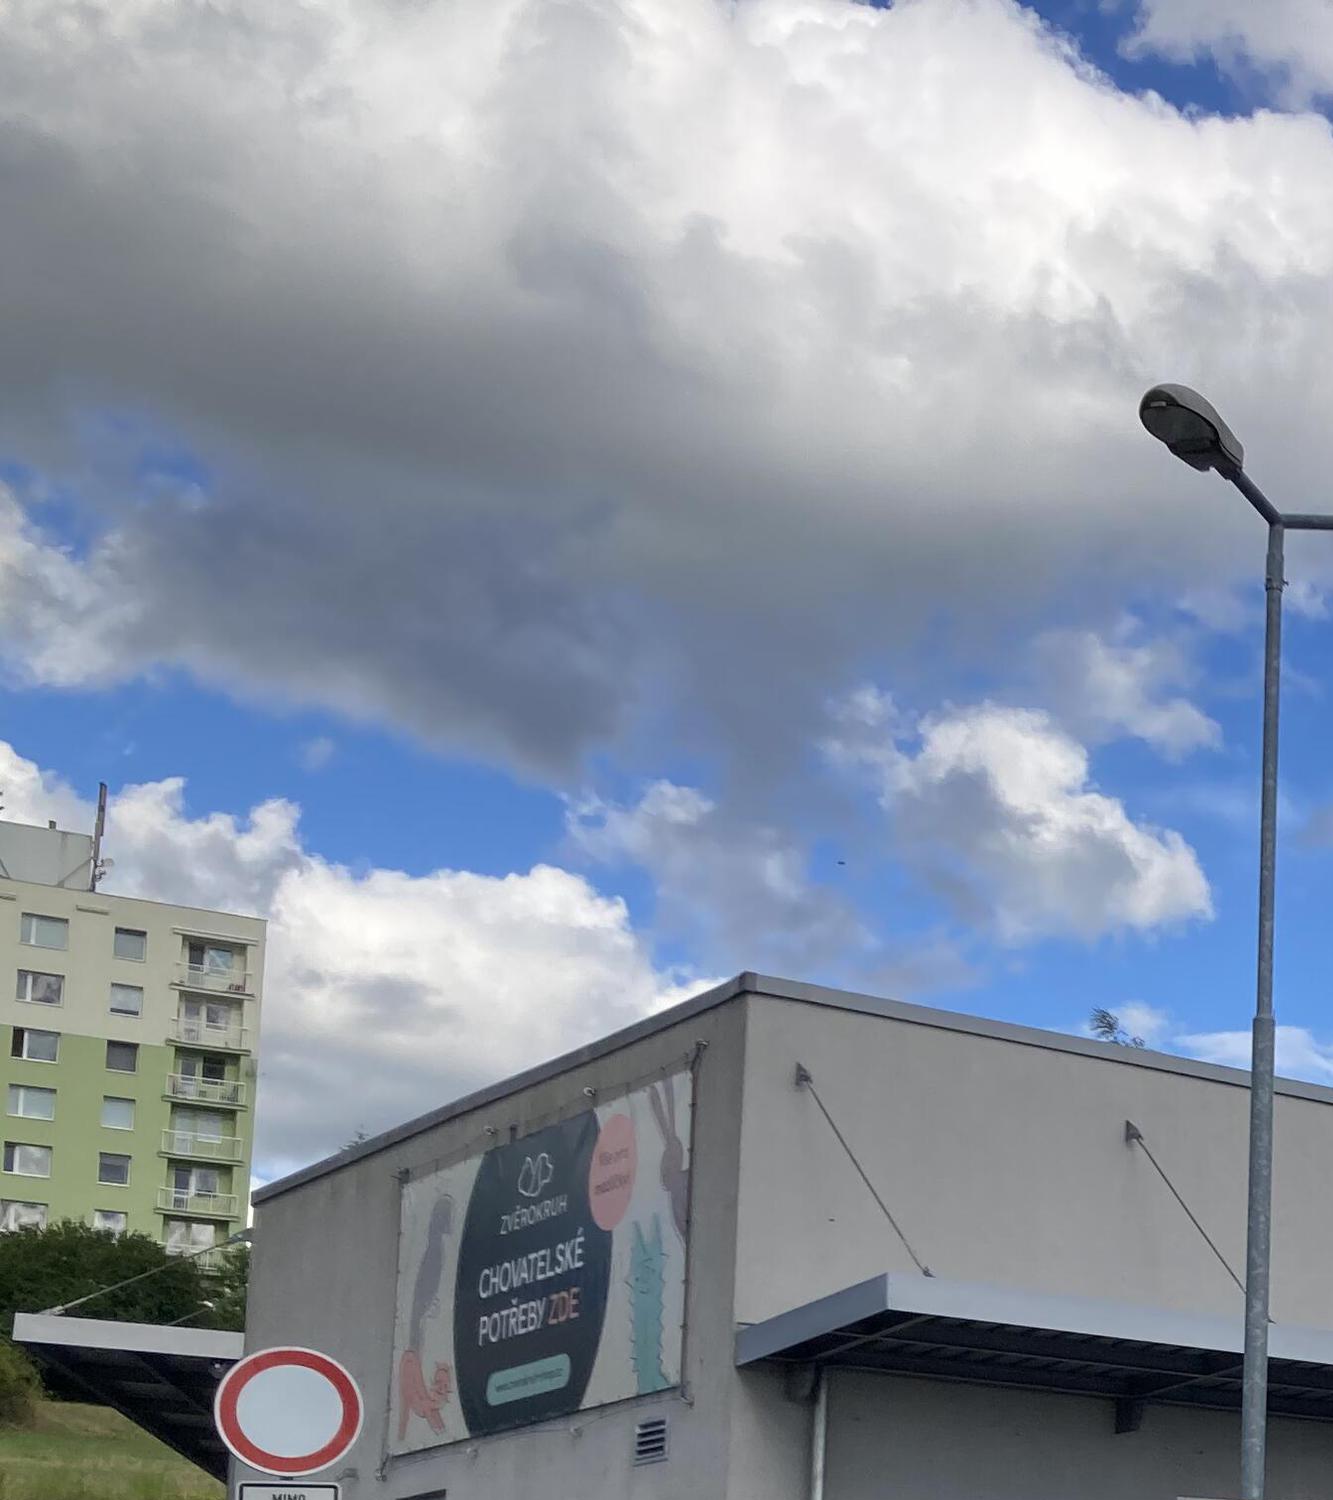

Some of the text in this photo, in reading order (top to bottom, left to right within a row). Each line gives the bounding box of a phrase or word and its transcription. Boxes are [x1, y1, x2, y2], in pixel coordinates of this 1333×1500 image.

[500, 1194, 568, 1236] ZVĚROKRUH
[478, 1227, 586, 1299] CHOVATELSKÉ
[478, 1287, 581, 1346] POTŘEBY ZDE
